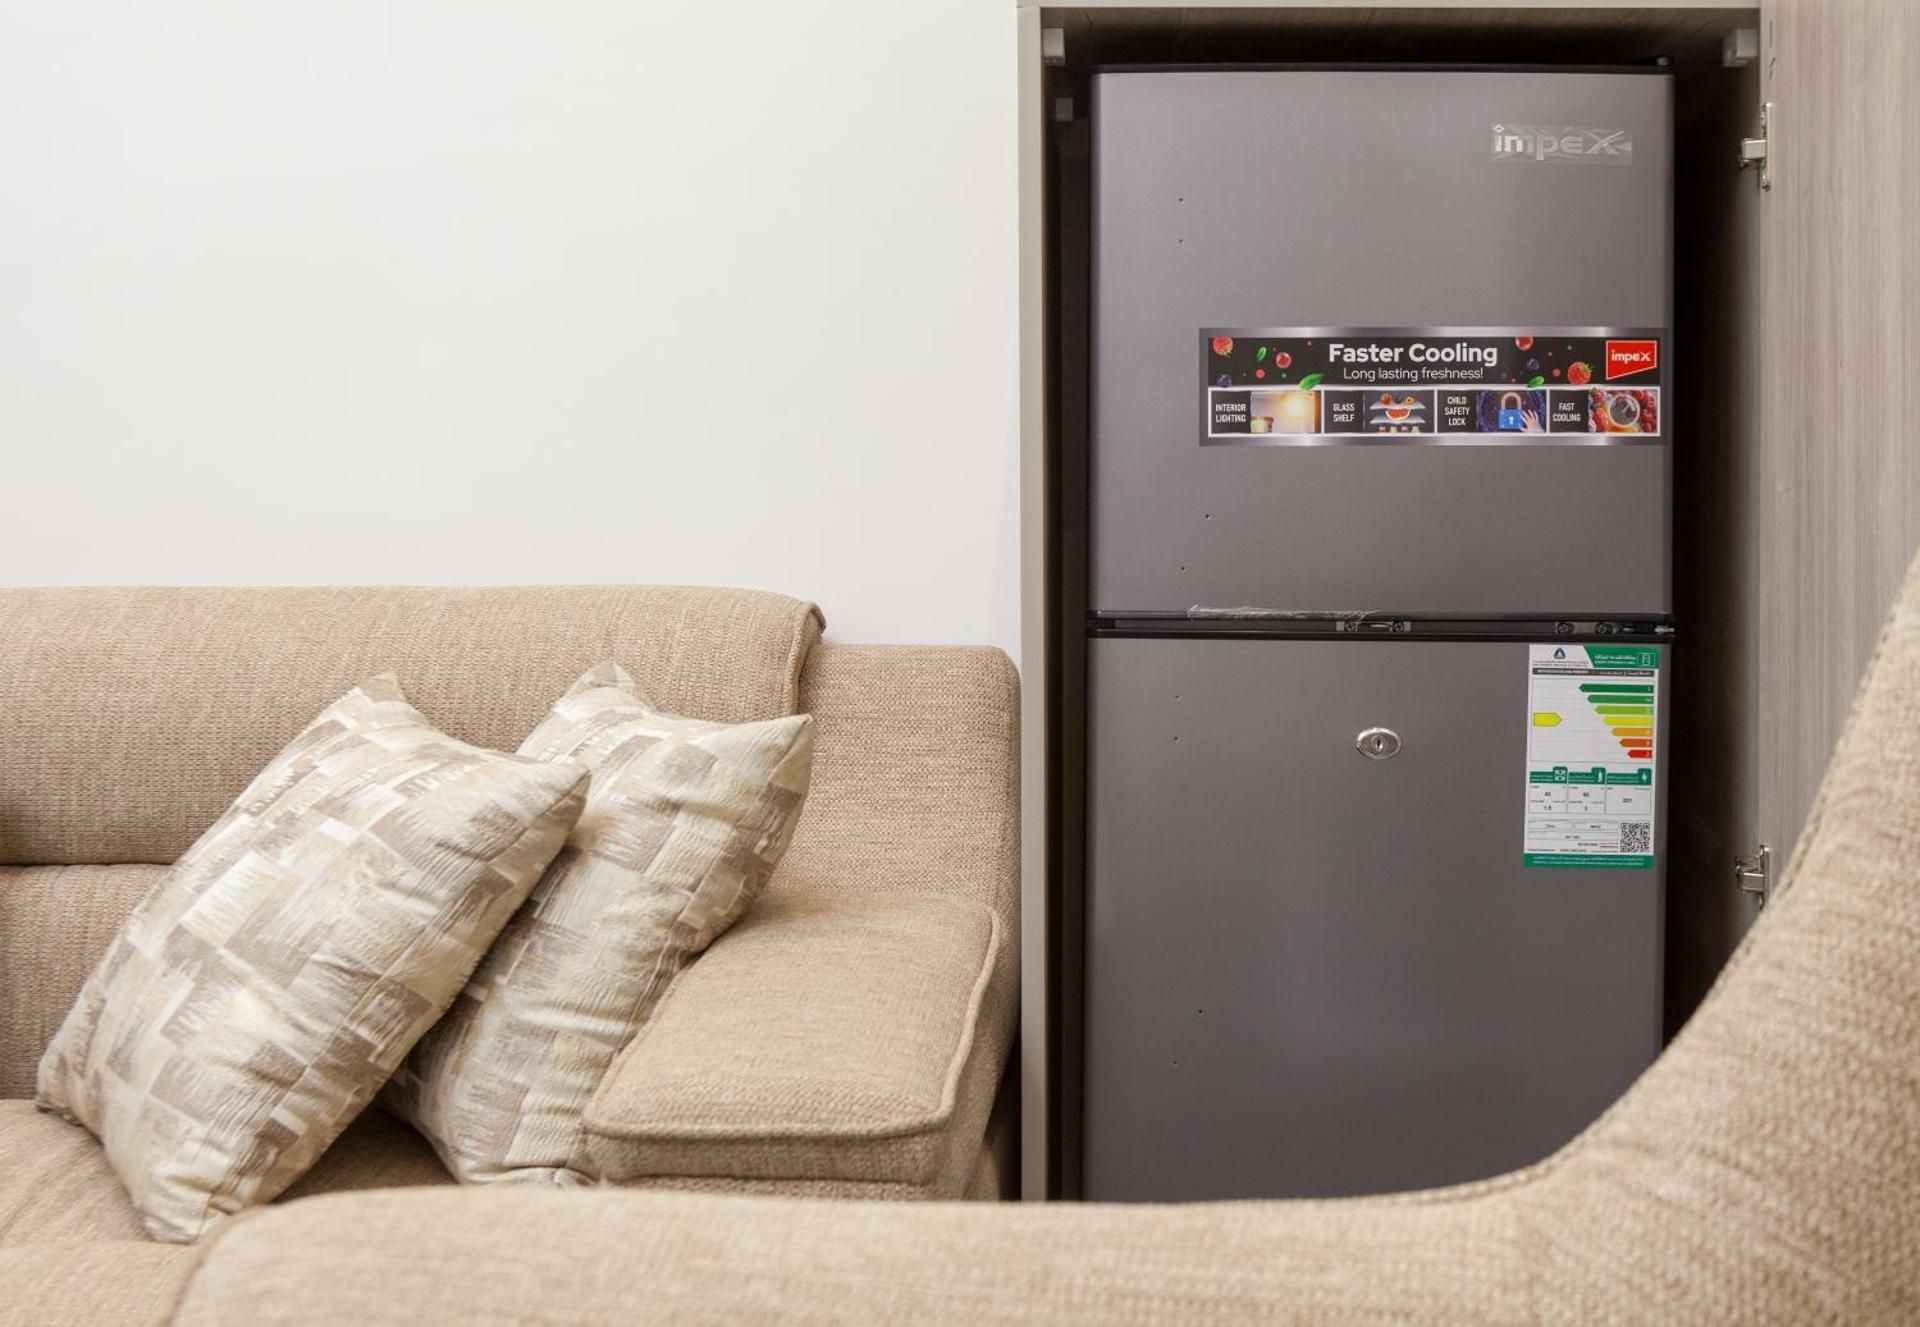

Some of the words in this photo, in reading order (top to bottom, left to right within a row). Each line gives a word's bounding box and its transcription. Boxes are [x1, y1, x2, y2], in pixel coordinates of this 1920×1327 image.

[1329, 343, 1404, 363] Faster
[1408, 342, 1498, 367] Cooling
[1343, 368, 1376, 382] Long
[1378, 367, 1419, 382] lasting
[1421, 366, 1484, 379] freshness!
[1447, 396, 1467, 405] CHILD
[1215, 403, 1247, 412] INTERIOR
[1333, 403, 1355, 412] GLASS
[1558, 402, 1576, 411] FAST
[1444, 407, 1470, 416] SAFETY
[1215, 414, 1247, 423] LIGHTING
[1333, 414, 1355, 422] SHELF
[1448, 418, 1466, 426] LOCK
[1552, 413, 1582, 422] COOLING
